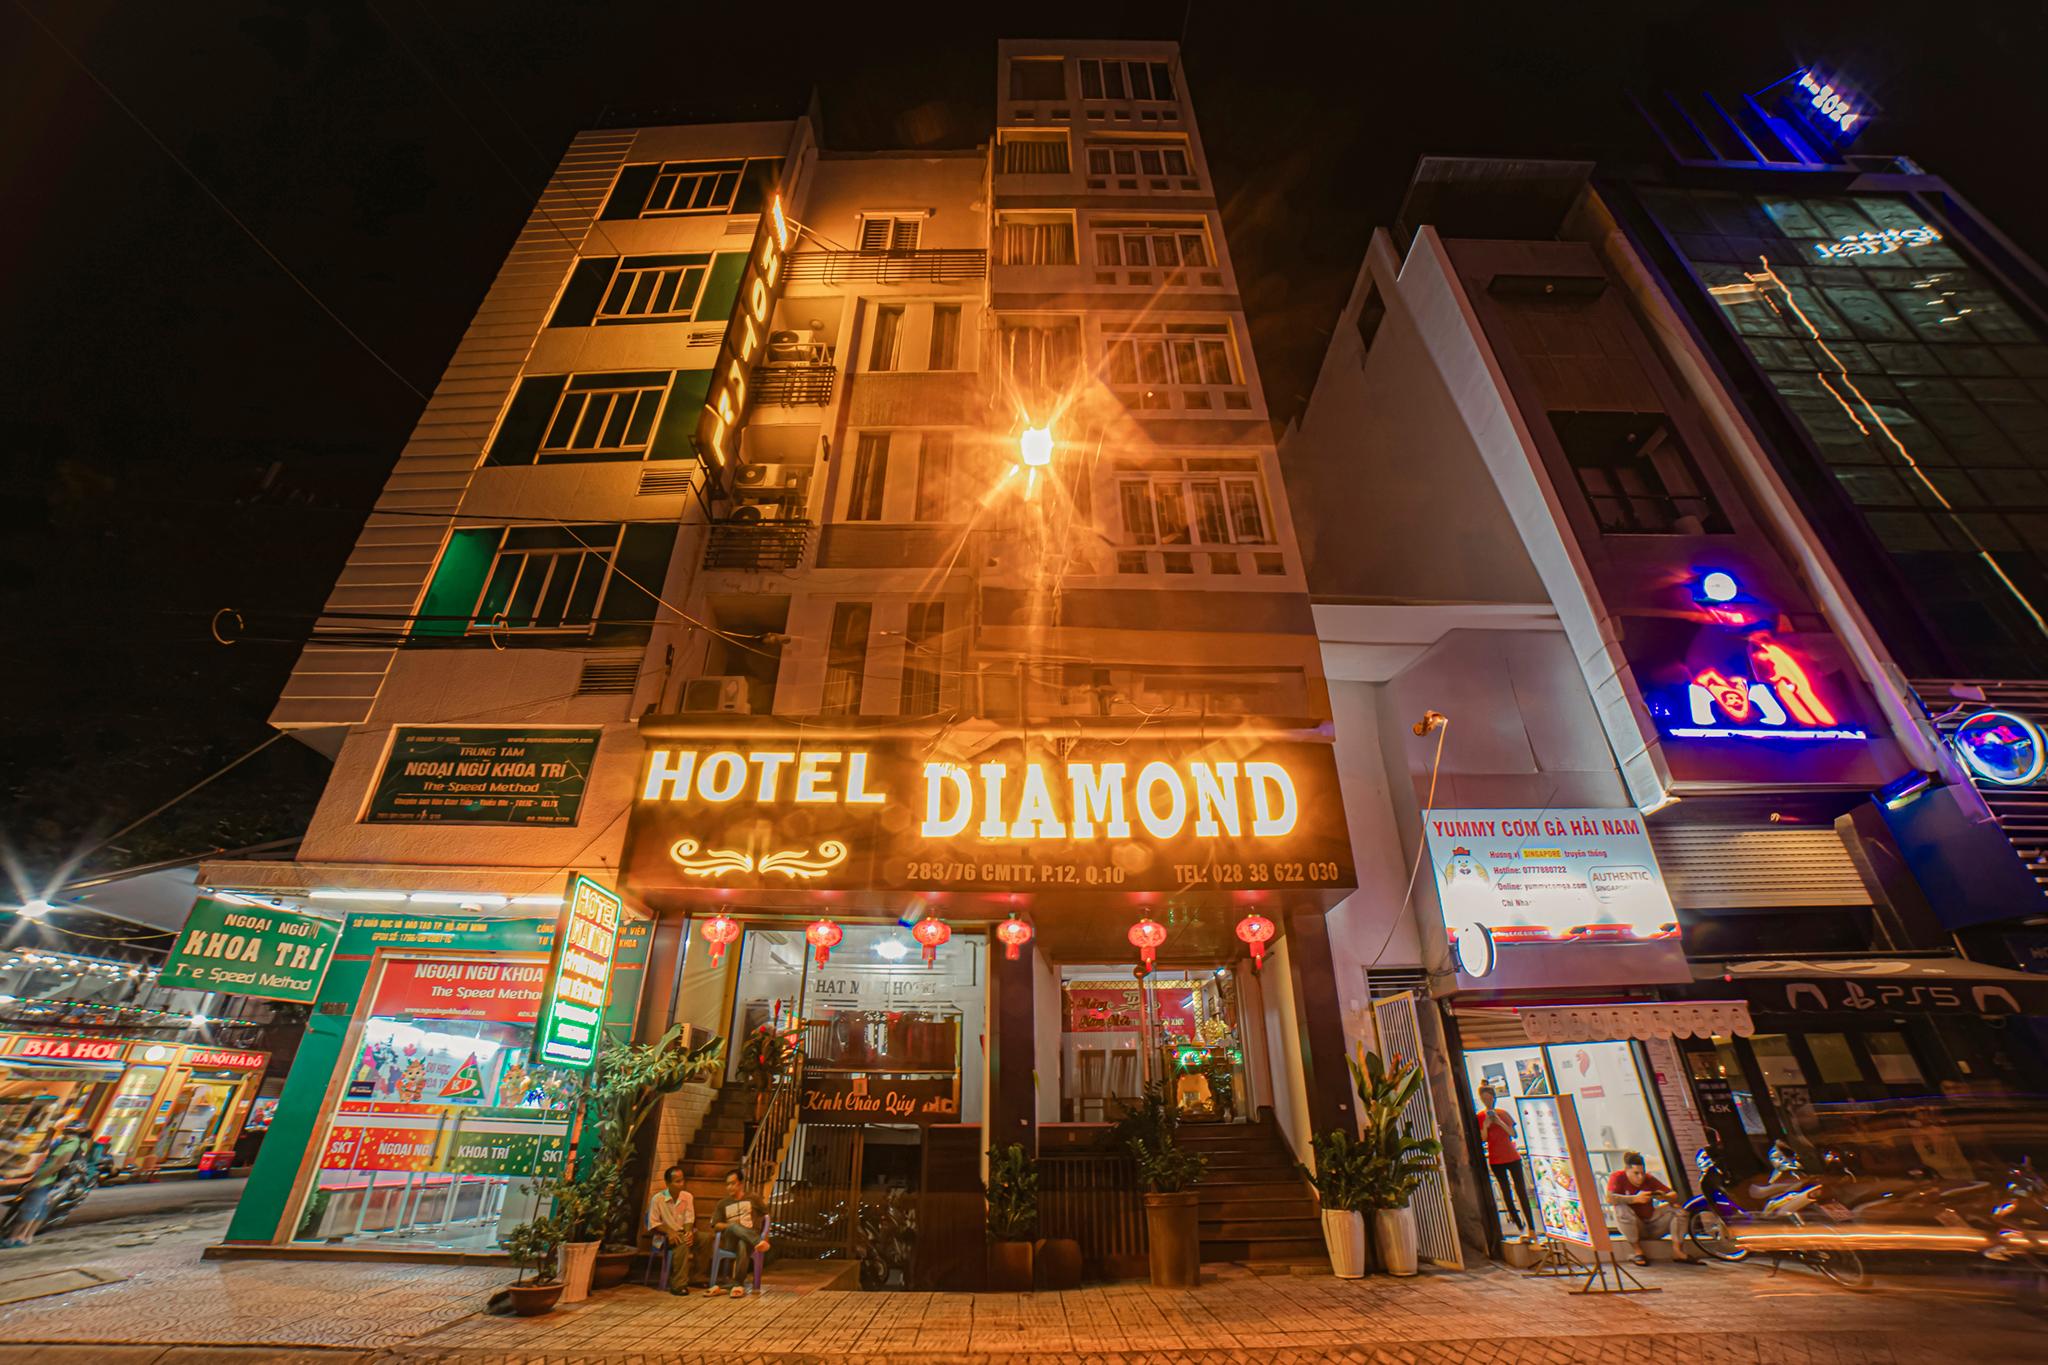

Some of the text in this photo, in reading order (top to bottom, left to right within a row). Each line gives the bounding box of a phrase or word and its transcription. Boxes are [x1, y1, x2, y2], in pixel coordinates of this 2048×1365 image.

[460, 747, 496, 756] TRUNG
[404, 761, 454, 779] NGOẠI
[491, 763, 536, 777] KHOA
[643, 750, 887, 803] HOTEL
[448, 782, 486, 792] Speed
[489, 782, 540, 792] Method
[921, 760, 1298, 838] DIAMOND
[1433, 821, 1496, 837] YUMMY
[1546, 817, 1567, 836] GÀ
[1572, 815, 1599, 836] HẢI
[1603, 818, 1640, 835] NAM
[1524, 850, 1561, 858] SINGAPORE
[906, 862, 1125, 885] 283/76 CMTT, P.12, Q.10
[1174, 862, 1338, 883] TEL: 028 38 622 030
[1592, 871, 1649, 882] AUTHENTIC
[576, 885, 617, 932] HOTEL
[224, 913, 273, 933] NGOẠI
[182, 930, 327, 971] KHOA TRÍ
[208, 967, 255, 984] Speed
[258, 973, 312, 991] Method
[414, 963, 461, 982] NGOẠI
[501, 966, 544, 982] KHOA
[431, 986, 543, 1000] The Speed Metho
[1876, 985, 1961, 1006] PS5
[22, 1040, 73, 1057] BIA
[885, 1091, 916, 1116] Quý
[331, 1141, 355, 1154] SKT
[457, 1144, 510, 1161] KHOA TRÍ
